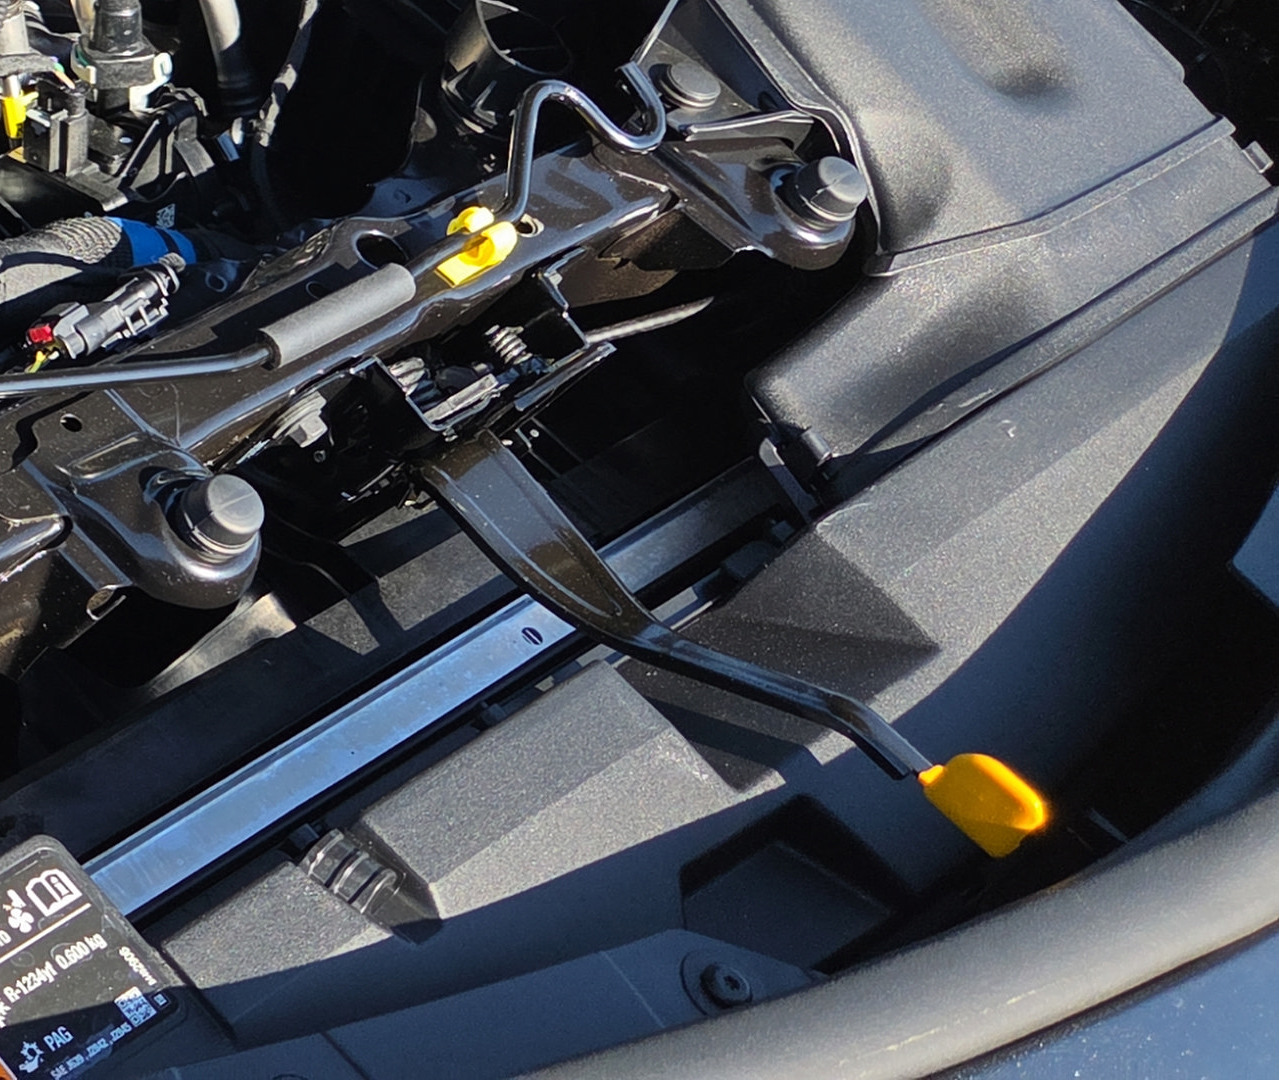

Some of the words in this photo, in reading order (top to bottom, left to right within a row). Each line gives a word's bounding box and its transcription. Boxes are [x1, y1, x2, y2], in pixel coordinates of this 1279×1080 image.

[3, 961, 58, 1003] R-1234yf
[54, 941, 90, 970] 0.600
[84, 932, 108, 951] kg
[43, 1026, 74, 1052] PAG
